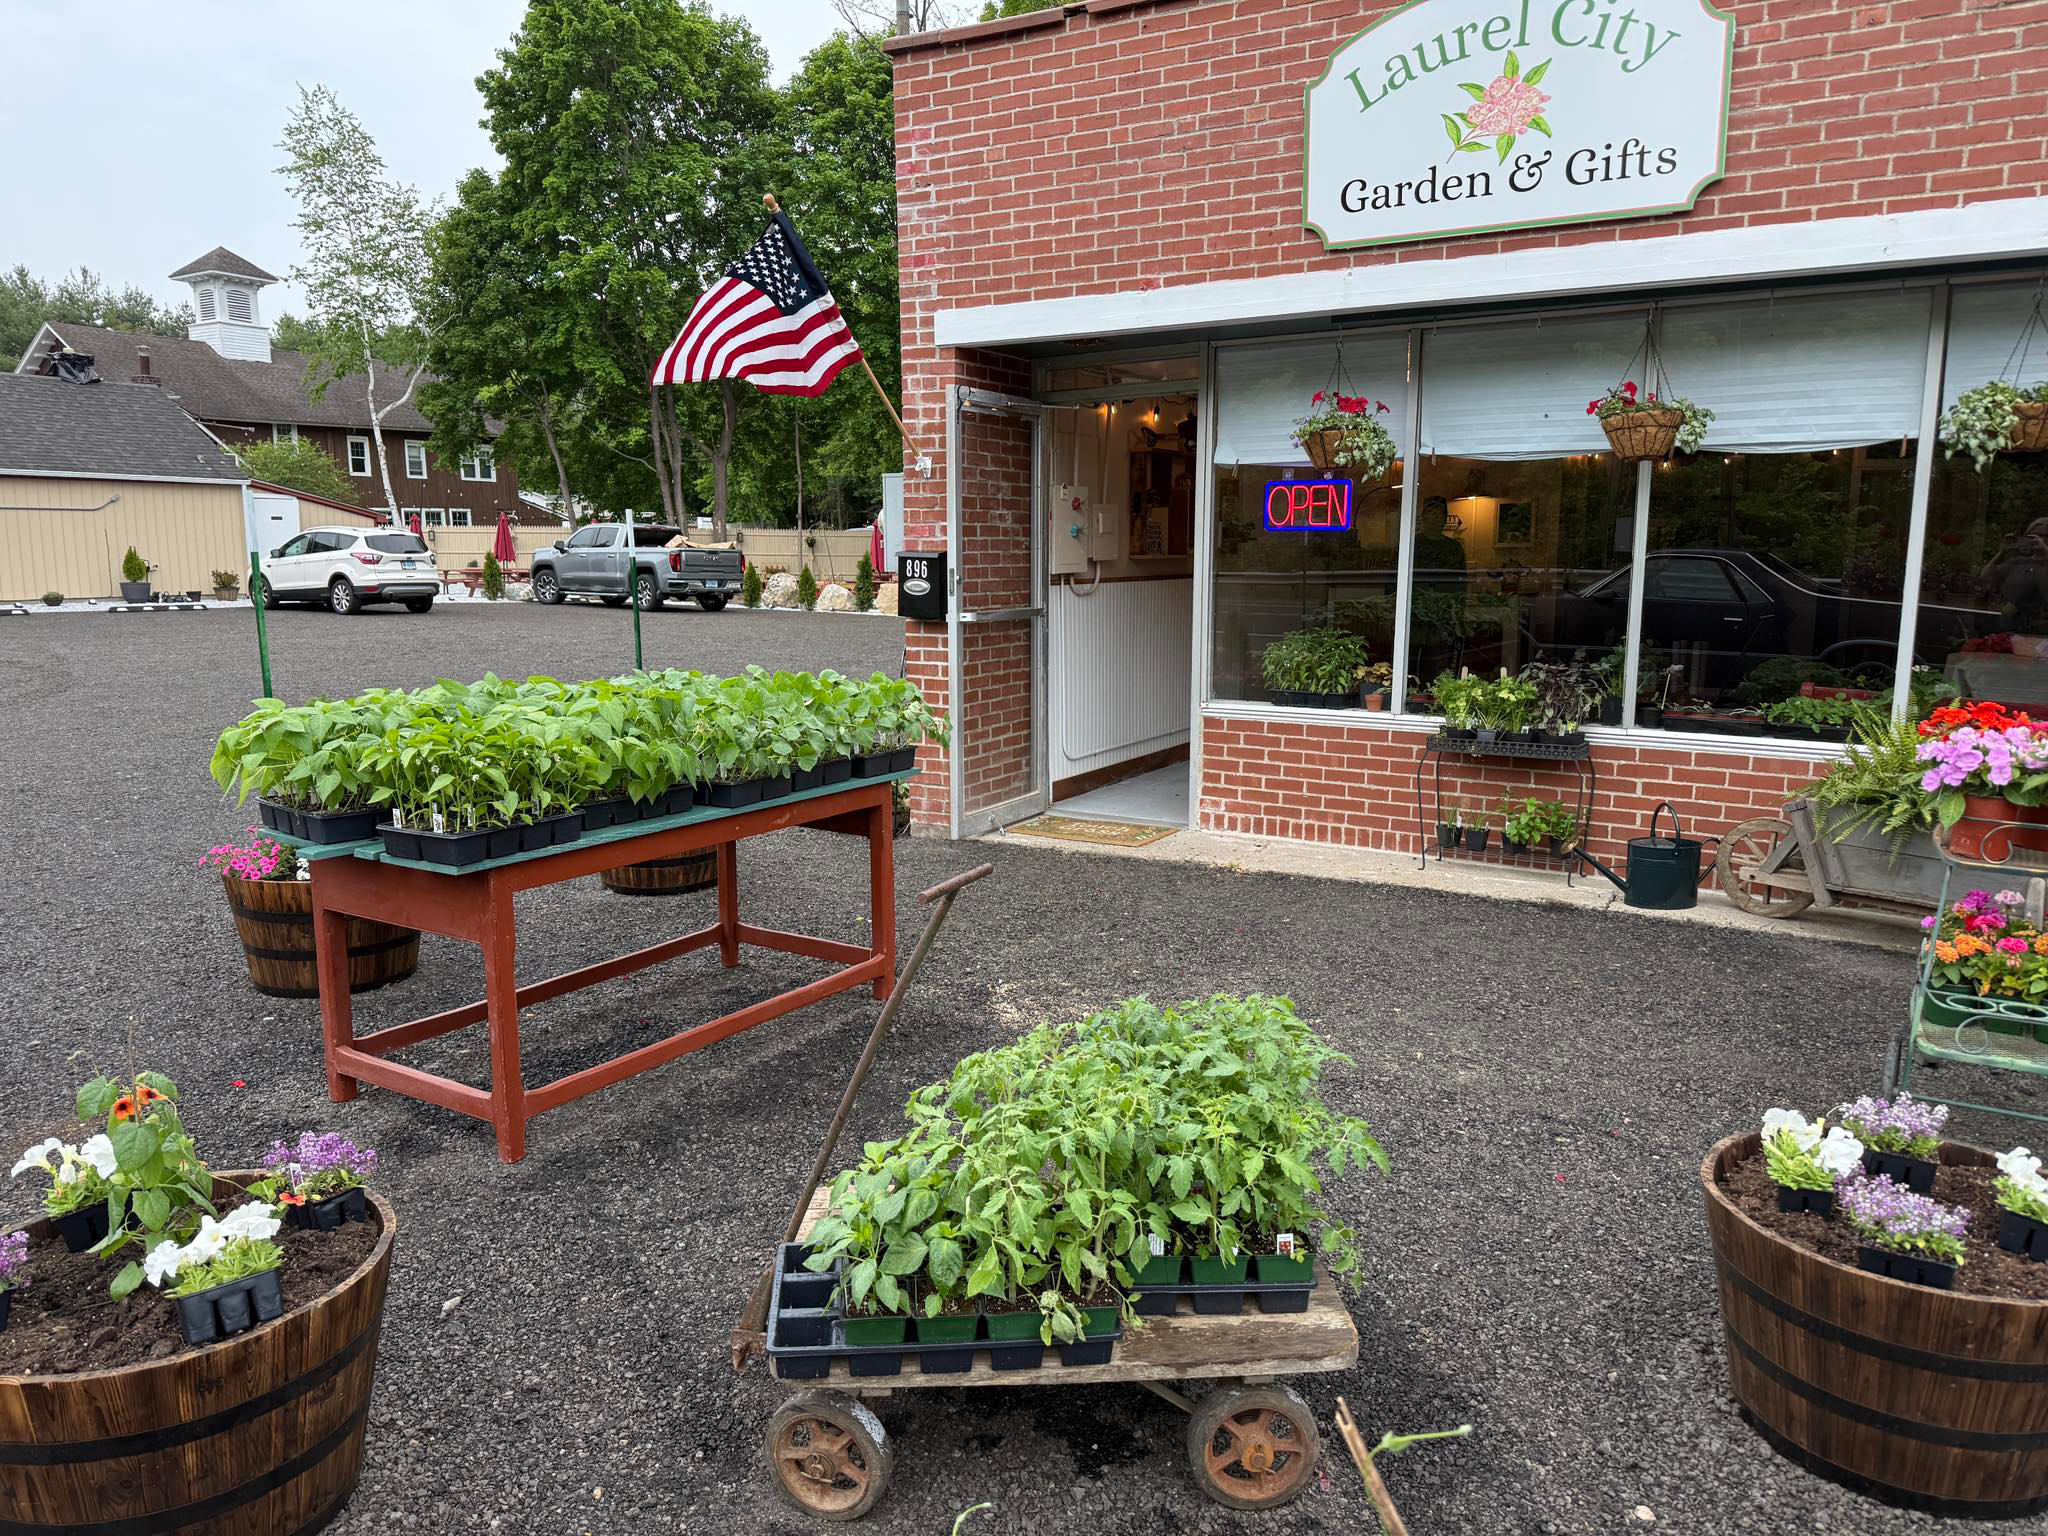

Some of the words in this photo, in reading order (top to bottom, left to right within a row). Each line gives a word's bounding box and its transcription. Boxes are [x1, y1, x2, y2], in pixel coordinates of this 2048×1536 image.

[1344, 0, 1530, 113] Laurel
[1551, 0, 1682, 74] City
[1340, 165, 1493, 213] Garden
[1508, 150, 1553, 192] &
[1565, 138, 1677, 186] Gifts
[1268, 485, 1349, 527] OPEN
[906, 559, 928, 579] 896
